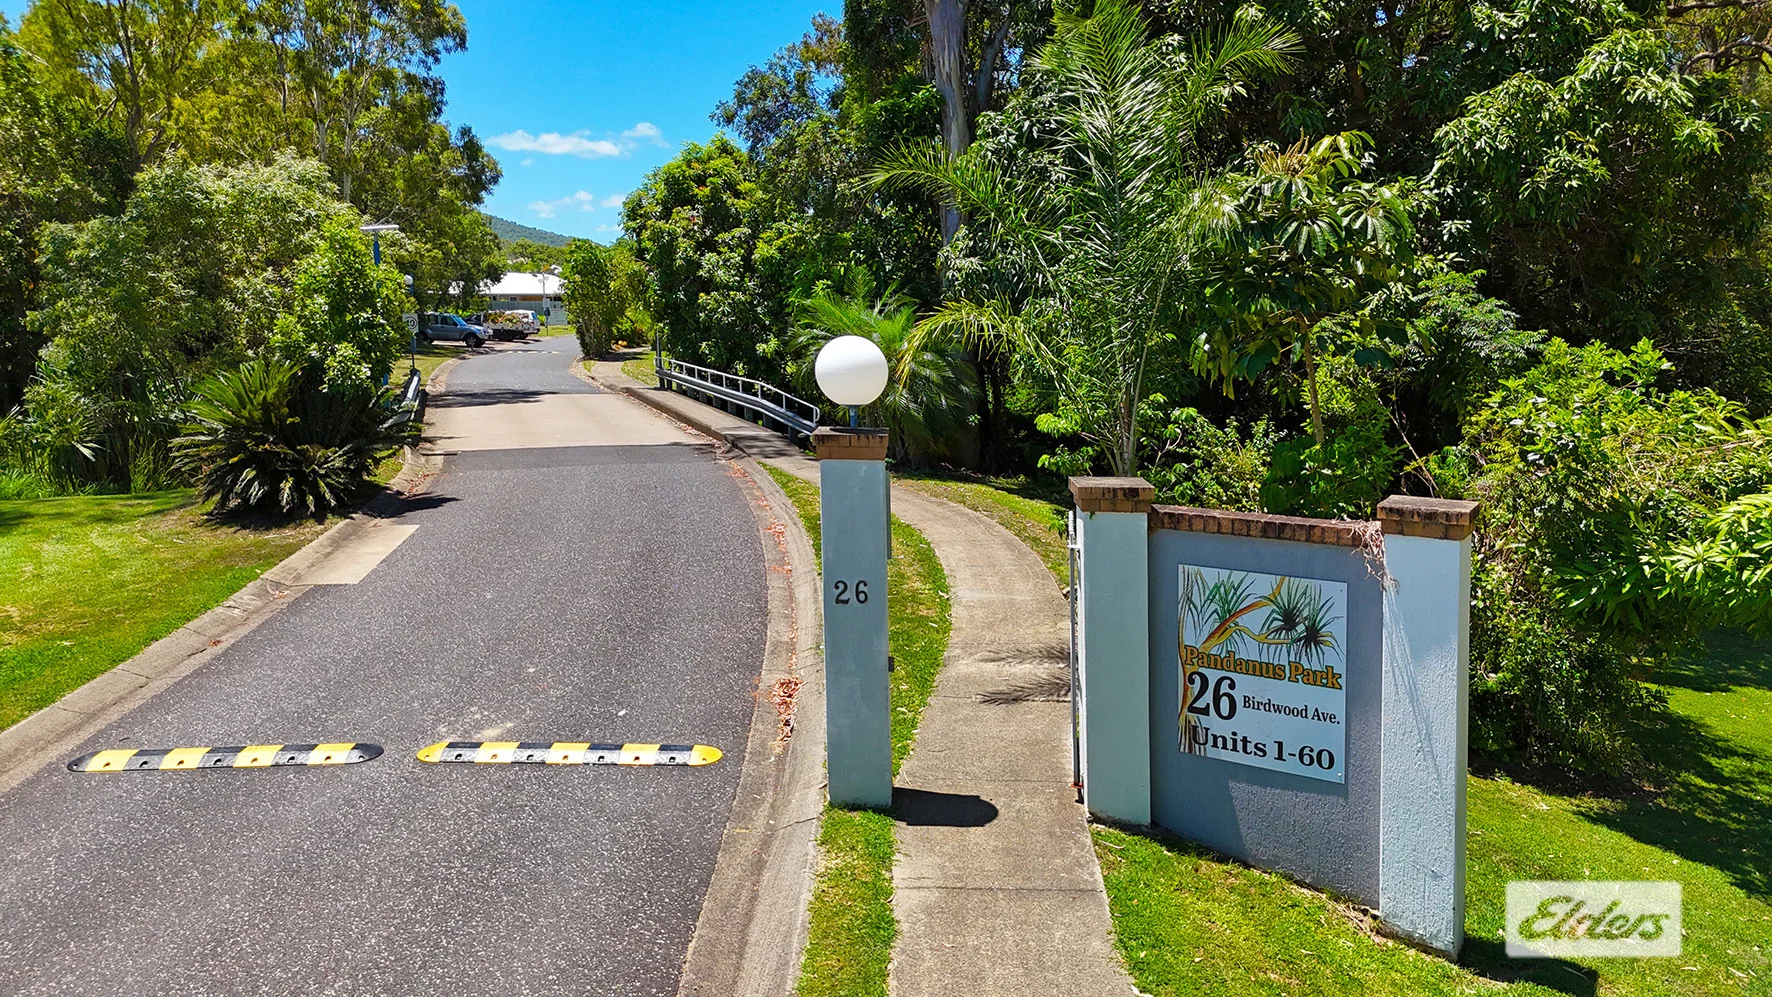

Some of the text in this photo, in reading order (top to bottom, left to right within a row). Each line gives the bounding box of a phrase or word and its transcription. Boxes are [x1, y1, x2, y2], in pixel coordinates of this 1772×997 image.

[834, 580, 868, 604] 26
[1184, 645, 1343, 690] Pandanus Park
[1187, 671, 1237, 720] 26
[1242, 695, 1341, 725] Birdwood Ave.
[1191, 724, 1335, 770] Units 1-60
